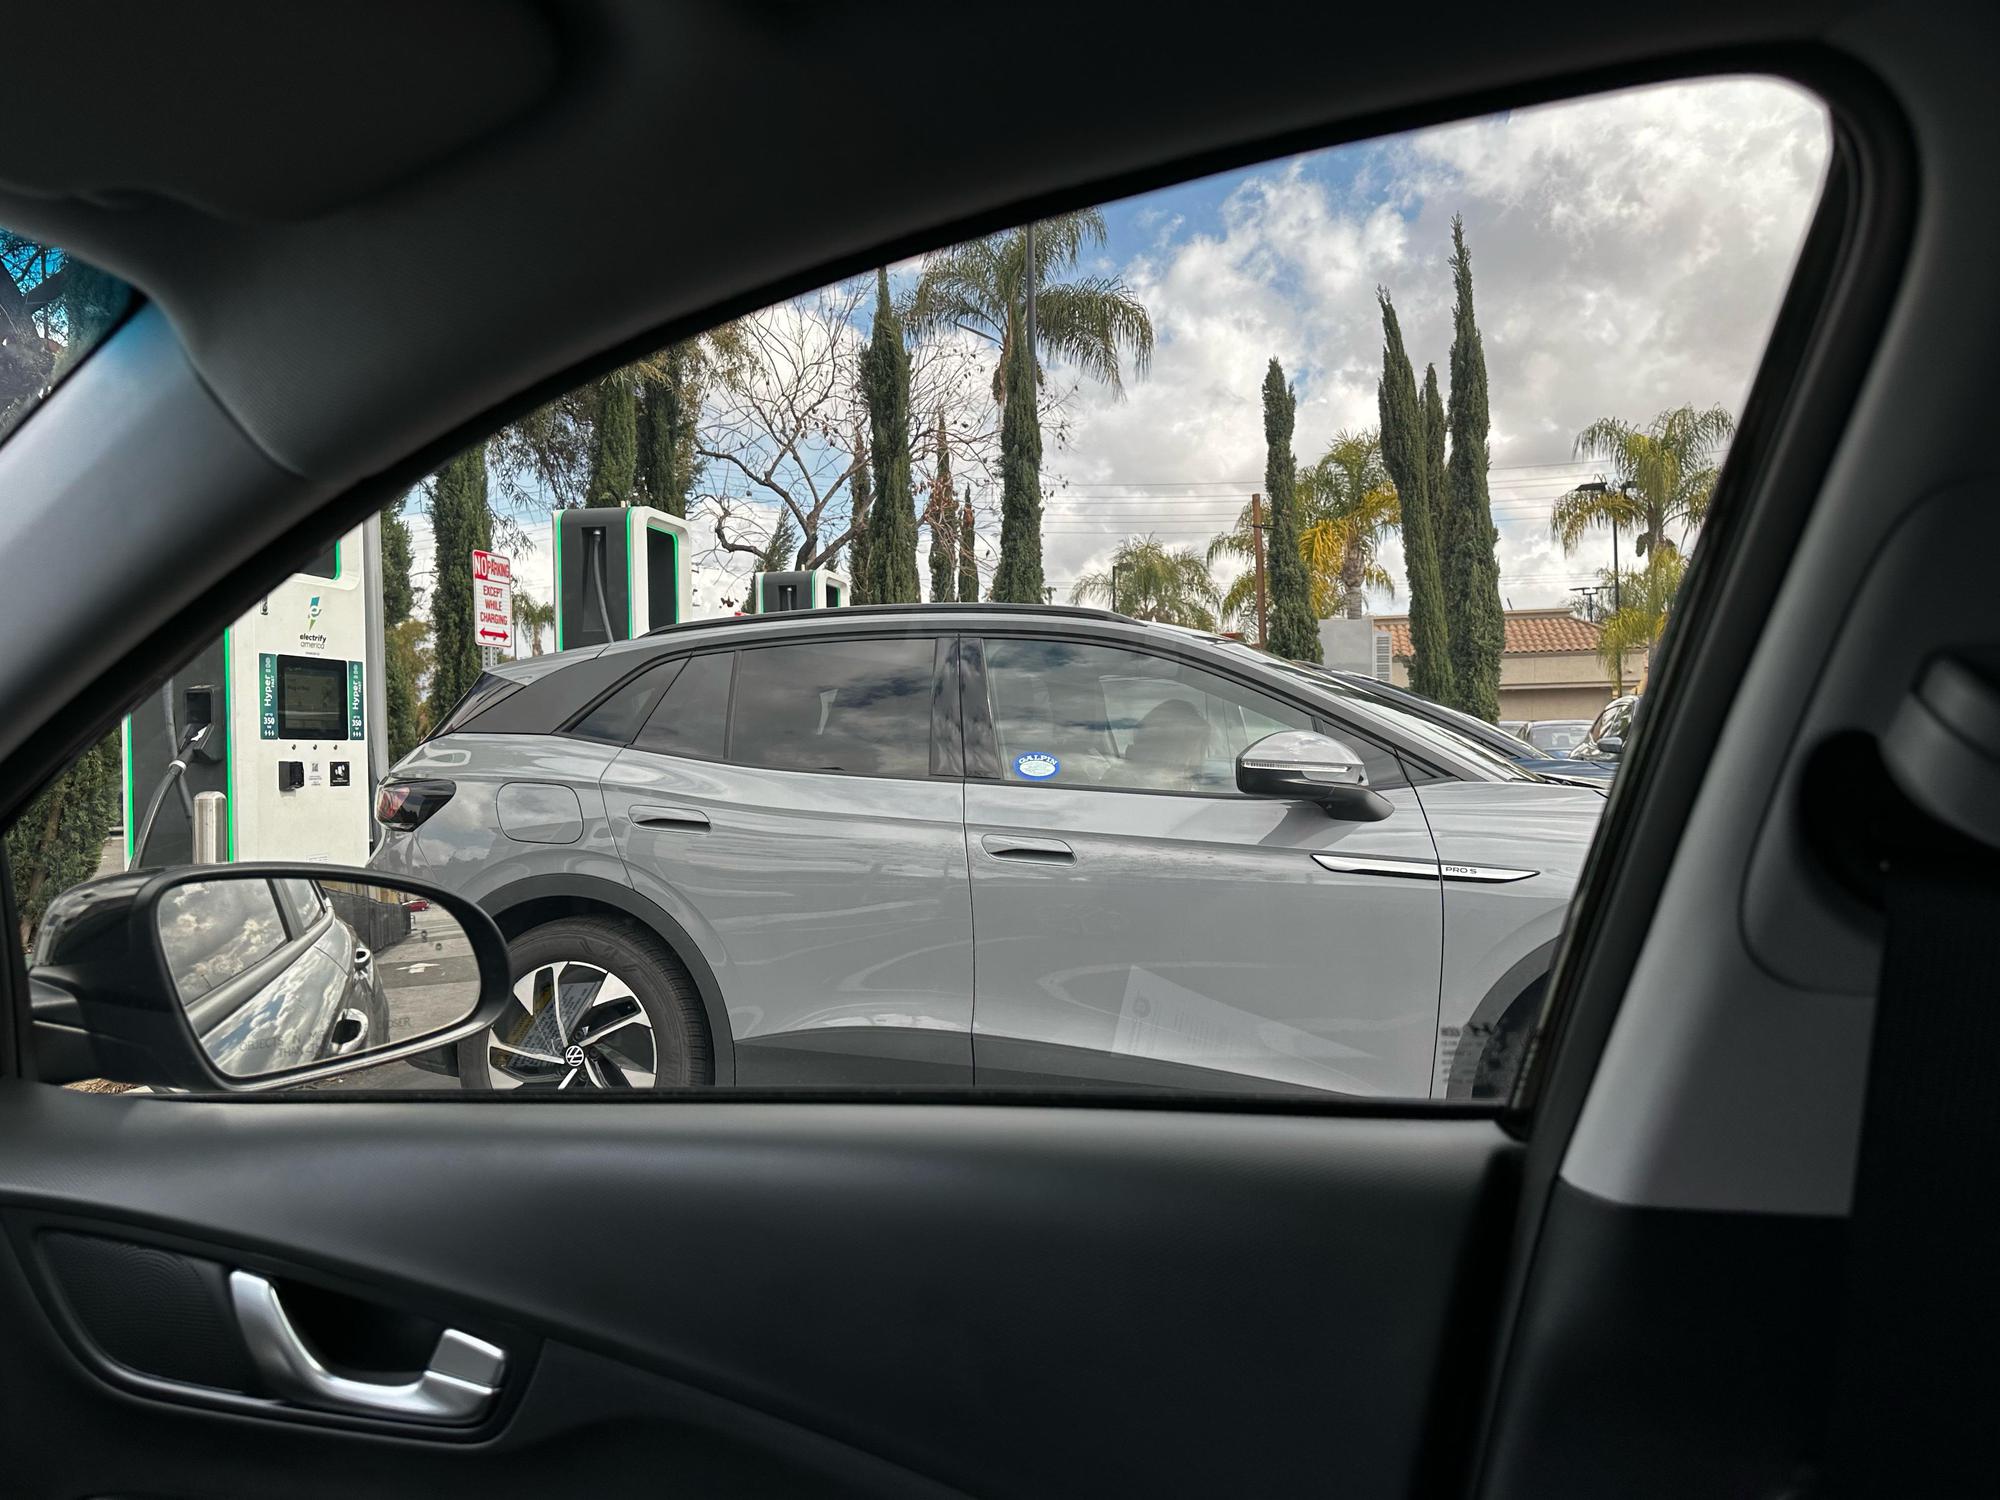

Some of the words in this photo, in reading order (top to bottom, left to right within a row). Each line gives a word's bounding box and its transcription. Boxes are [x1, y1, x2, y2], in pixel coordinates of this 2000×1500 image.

[474, 555, 487, 576] NO
[487, 562, 510, 577] PARKING
[483, 585, 503, 598] EXCEPT
[485, 600, 502, 611] WHILE
[480, 612, 508, 625] CHARGING
[300, 633, 326, 643] electrify
[301, 641, 325, 649] america
[264, 674, 272, 706] Hyper
[352, 680, 360, 710] Hyper
[264, 716, 275, 725] 350
[352, 719, 362, 727] 350
[1018, 754, 1058, 766] GALPIN
[1445, 866, 1468, 874] PRO
